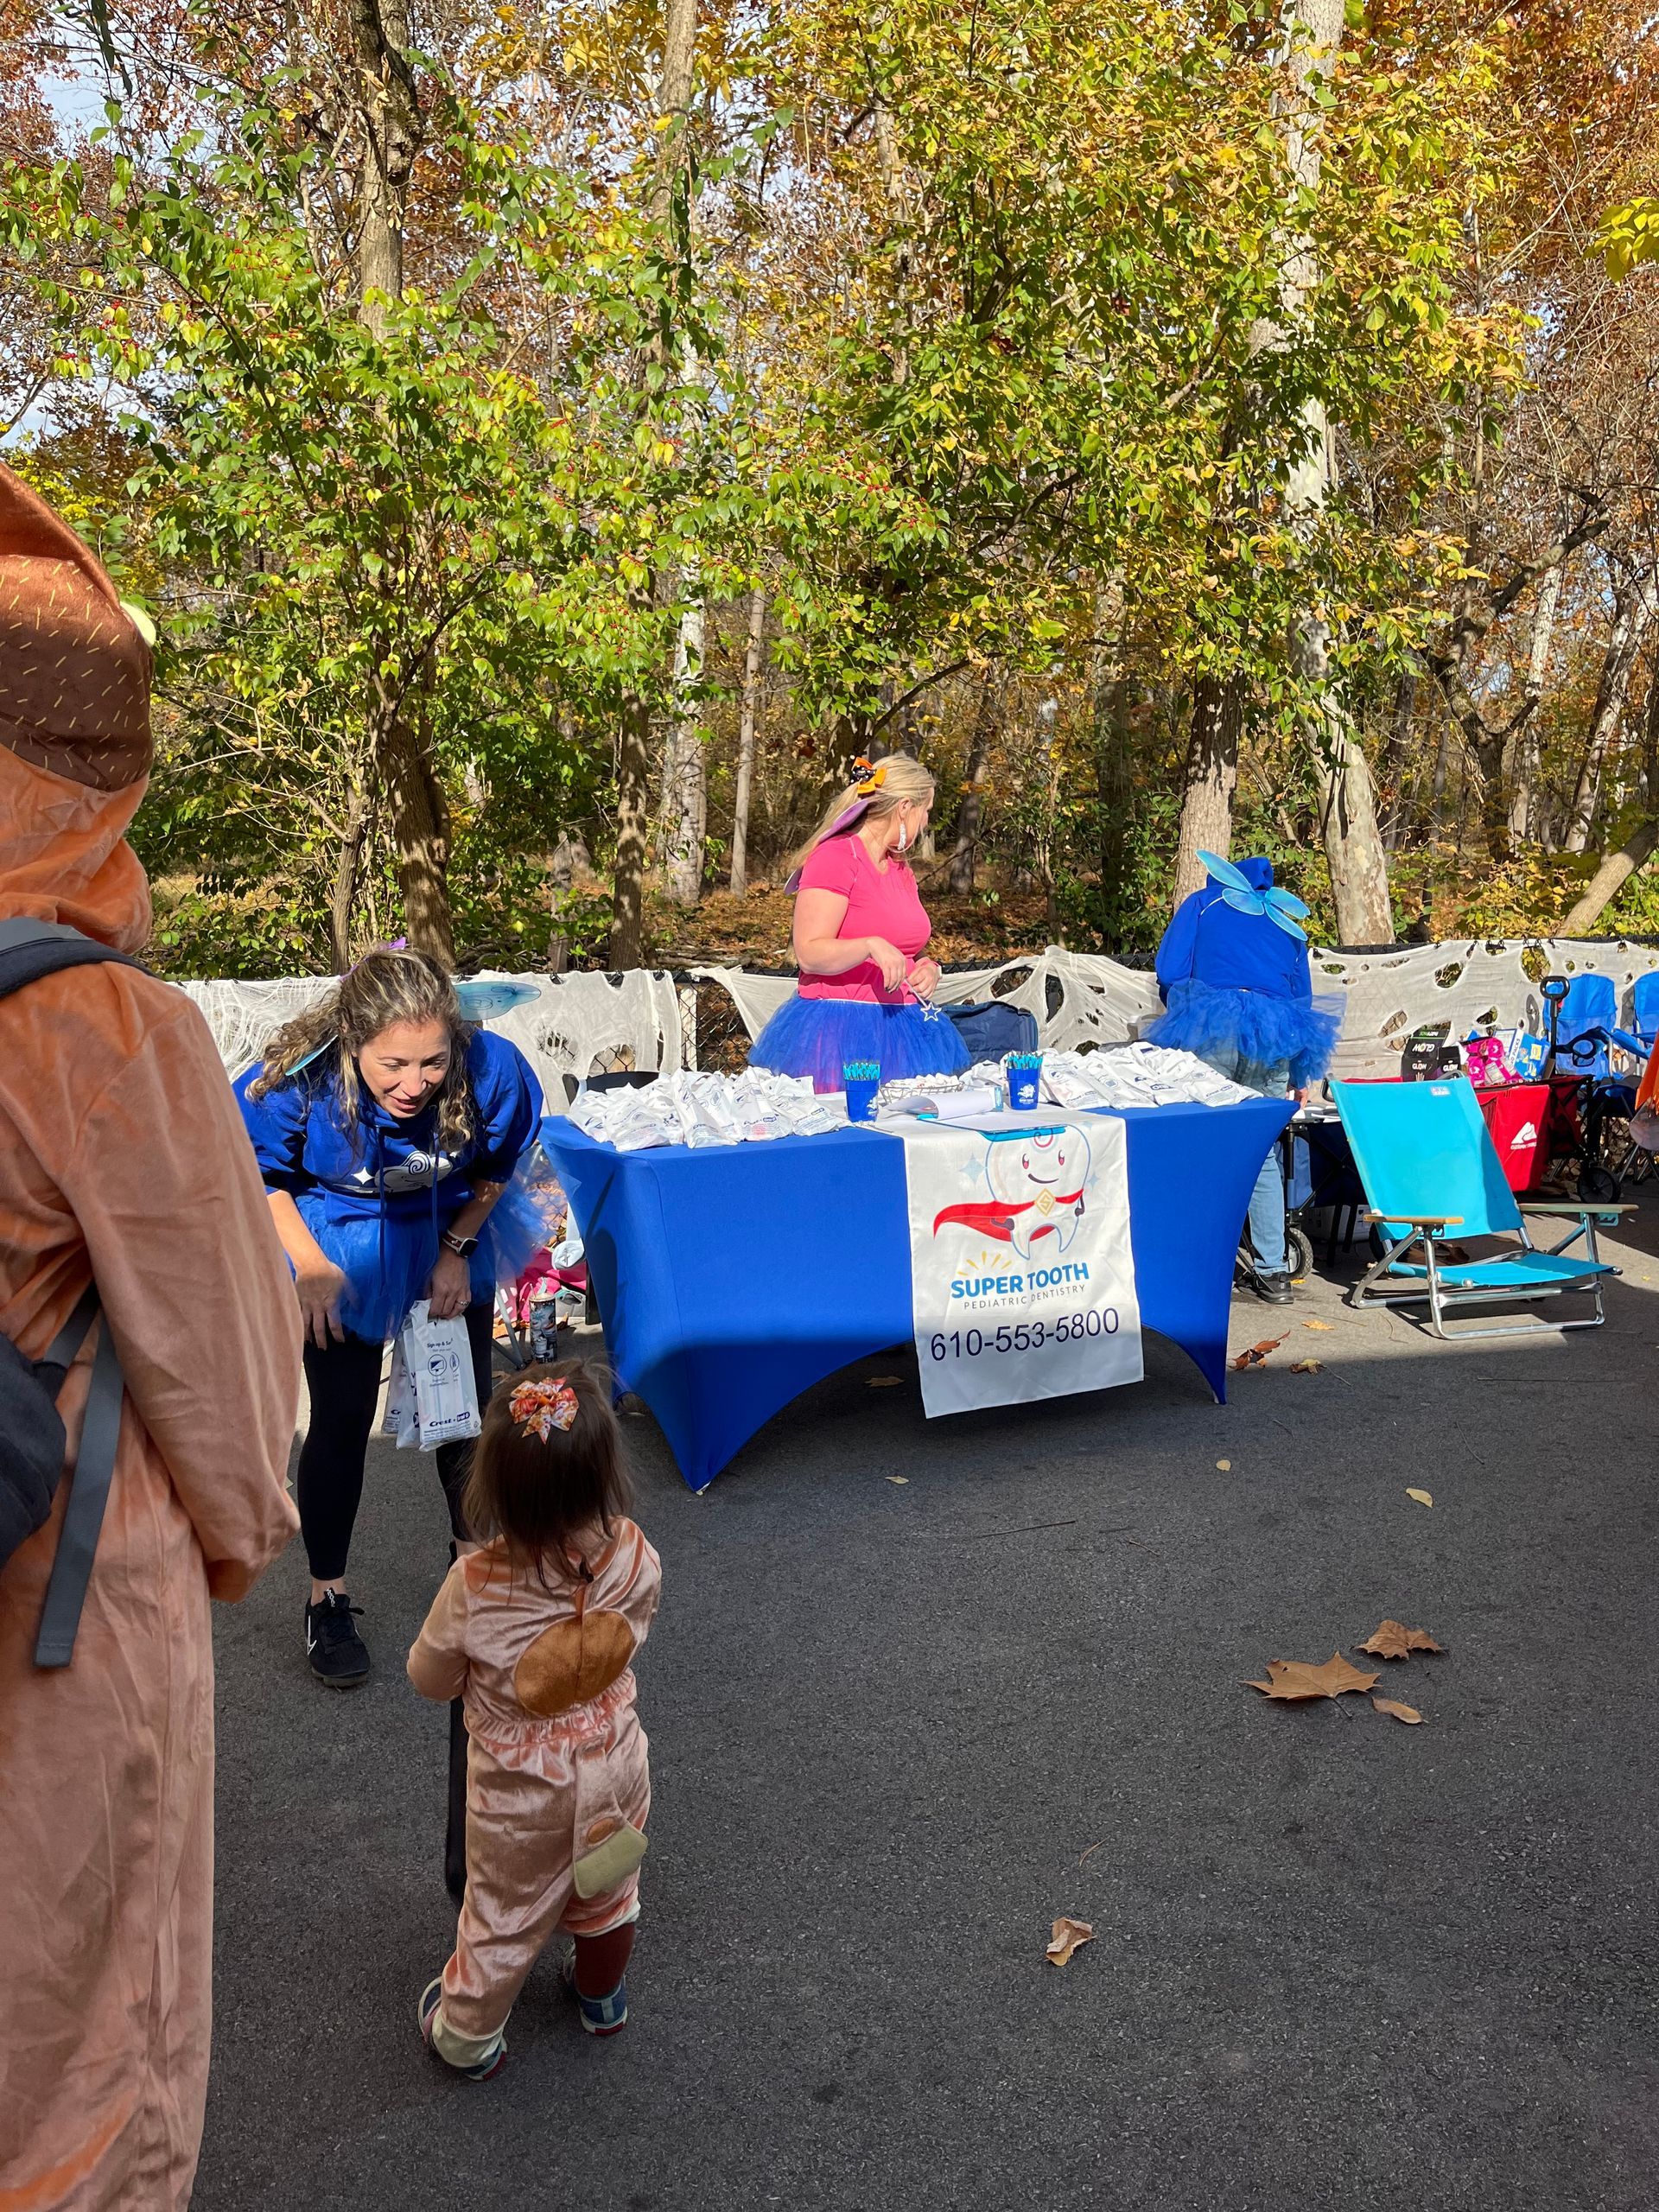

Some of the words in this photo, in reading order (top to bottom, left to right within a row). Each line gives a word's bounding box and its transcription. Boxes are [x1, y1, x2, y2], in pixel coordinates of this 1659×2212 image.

[1412, 1043, 1435, 1052] GLOW
[1442, 1064, 1459, 1072] GLOW
[950, 1275, 1024, 1299] SUPER
[1027, 1262, 1089, 1290] TOOTH
[964, 1296, 1027, 1309] PEDIATRIC
[1031, 1284, 1085, 1302] DENTISTRY
[931, 1307, 1119, 1361] 610-553-5800
[429, 1418, 451, 1427] Crest
